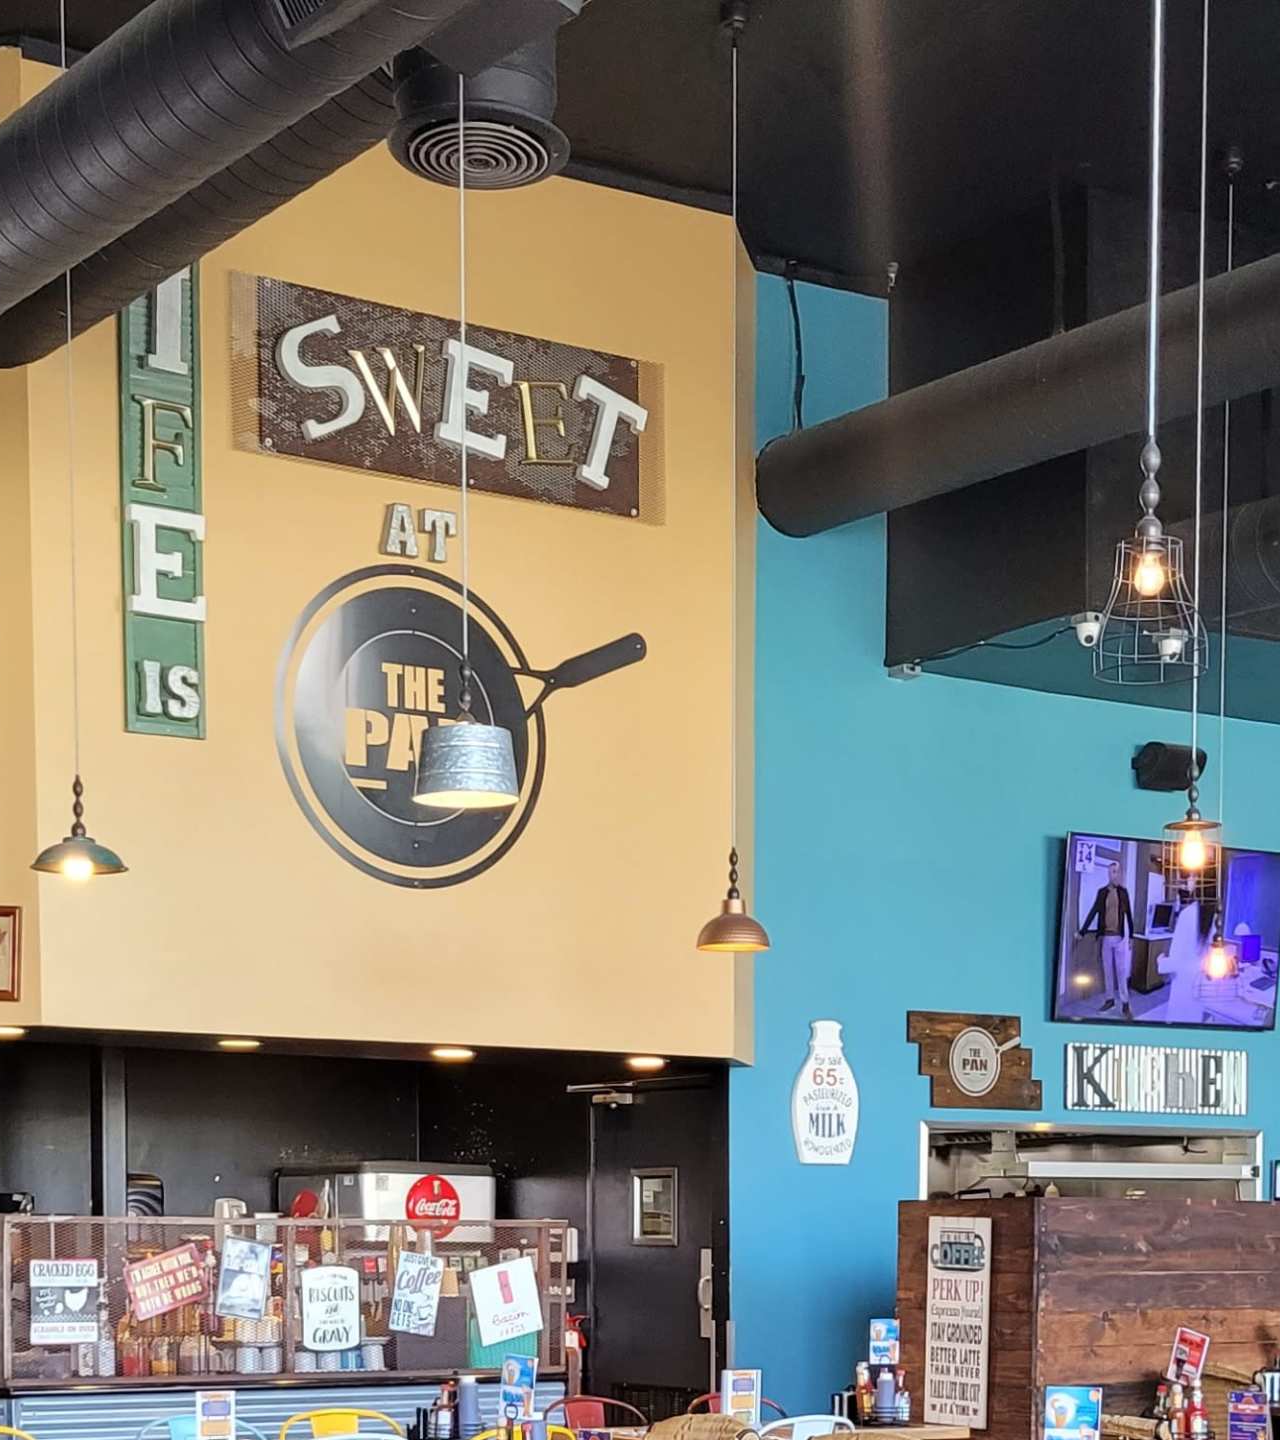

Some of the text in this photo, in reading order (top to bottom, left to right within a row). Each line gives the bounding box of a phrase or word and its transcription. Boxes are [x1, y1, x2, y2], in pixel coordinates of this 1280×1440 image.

[275, 314, 648, 491] SWEET
[125, 263, 206, 622] IFE
[380, 502, 457, 563] AT
[136, 658, 200, 722] IS
[381, 662, 447, 713] THE
[345, 707, 458, 772] PA
[969, 1047, 982, 1058] THE
[962, 1058, 988, 1072] PAN
[809, 1113, 846, 1138] MILK
[931, 1243, 985, 1267] COFFEE
[33, 1263, 95, 1277] CRACKED EGG
[397, 1267, 442, 1295] Coffee
[309, 1285, 355, 1304] BISCUITS
[932, 1278, 984, 1303] PERK UP!
[313, 1325, 352, 1344] GRAVY
[947, 1323, 982, 1345] GROUNDED
[930, 1346, 980, 1366] BETTER LATTE
[930, 1363, 980, 1379] THAN NEVER
